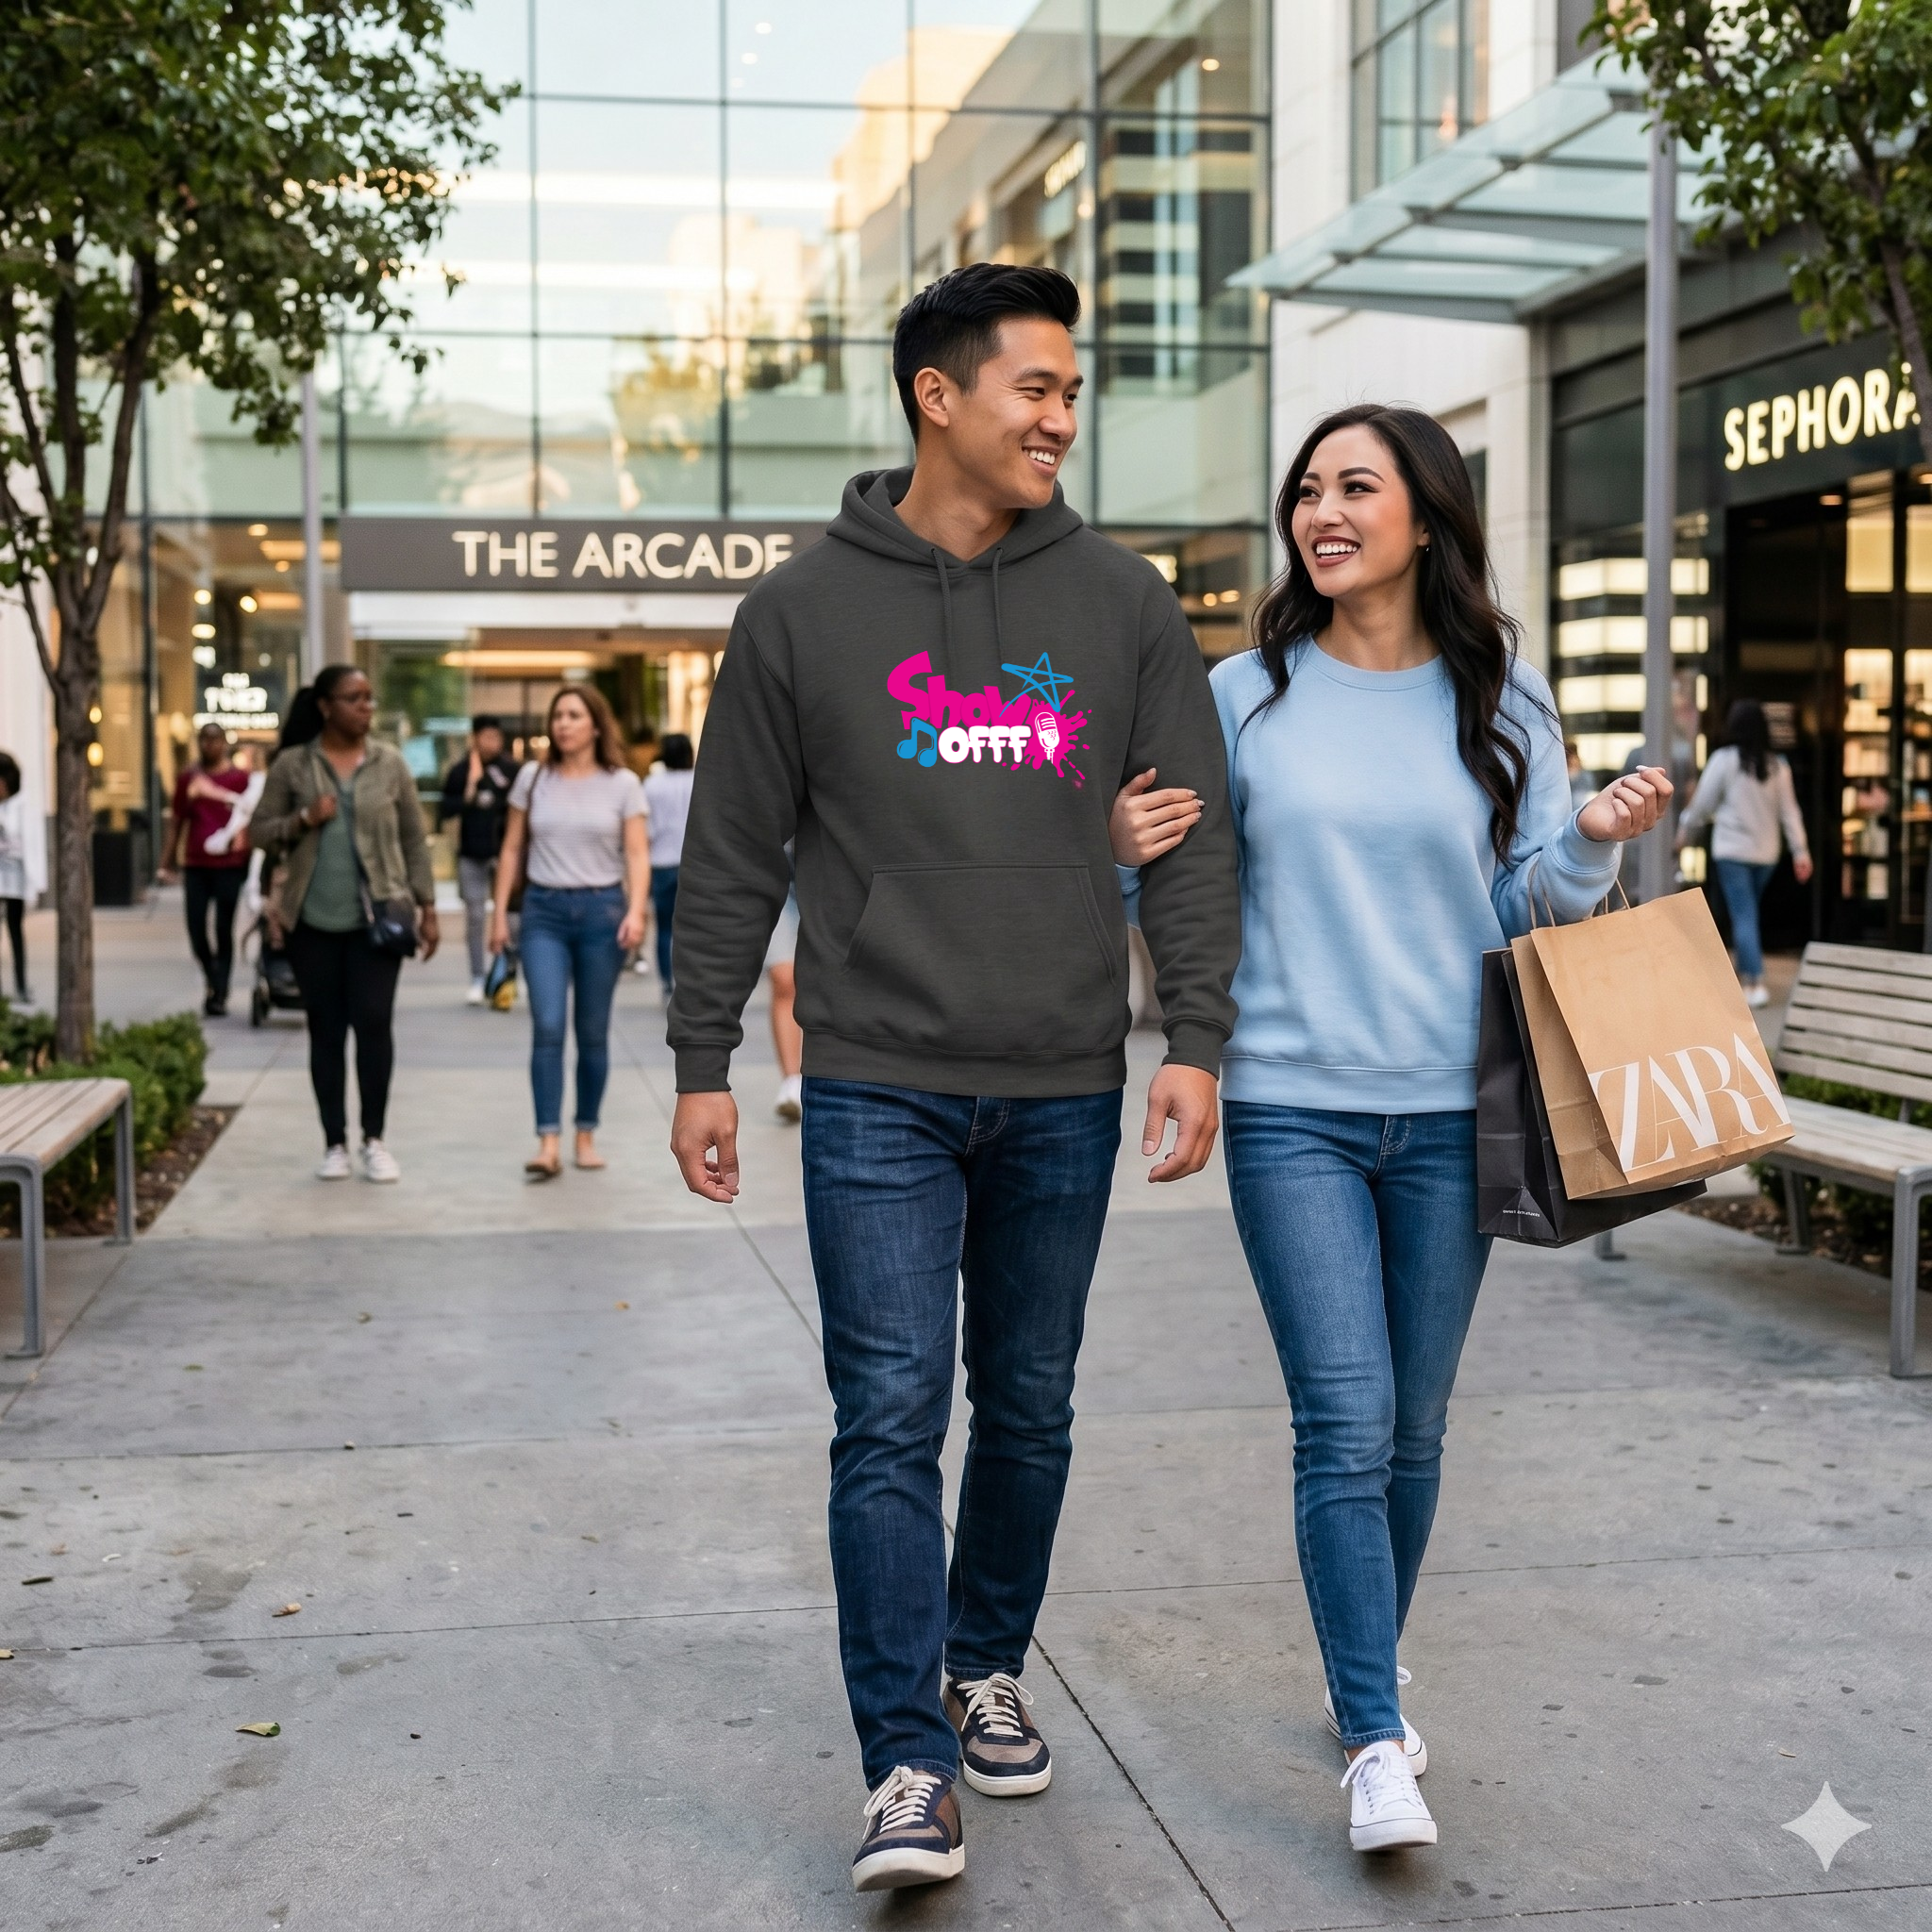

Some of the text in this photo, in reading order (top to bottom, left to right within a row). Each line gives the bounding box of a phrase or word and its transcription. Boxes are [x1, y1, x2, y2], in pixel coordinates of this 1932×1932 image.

[451, 531, 794, 579] THE ARCADE
[887, 650, 1032, 730] Show
[1588, 1032, 1791, 1173] ZARA
